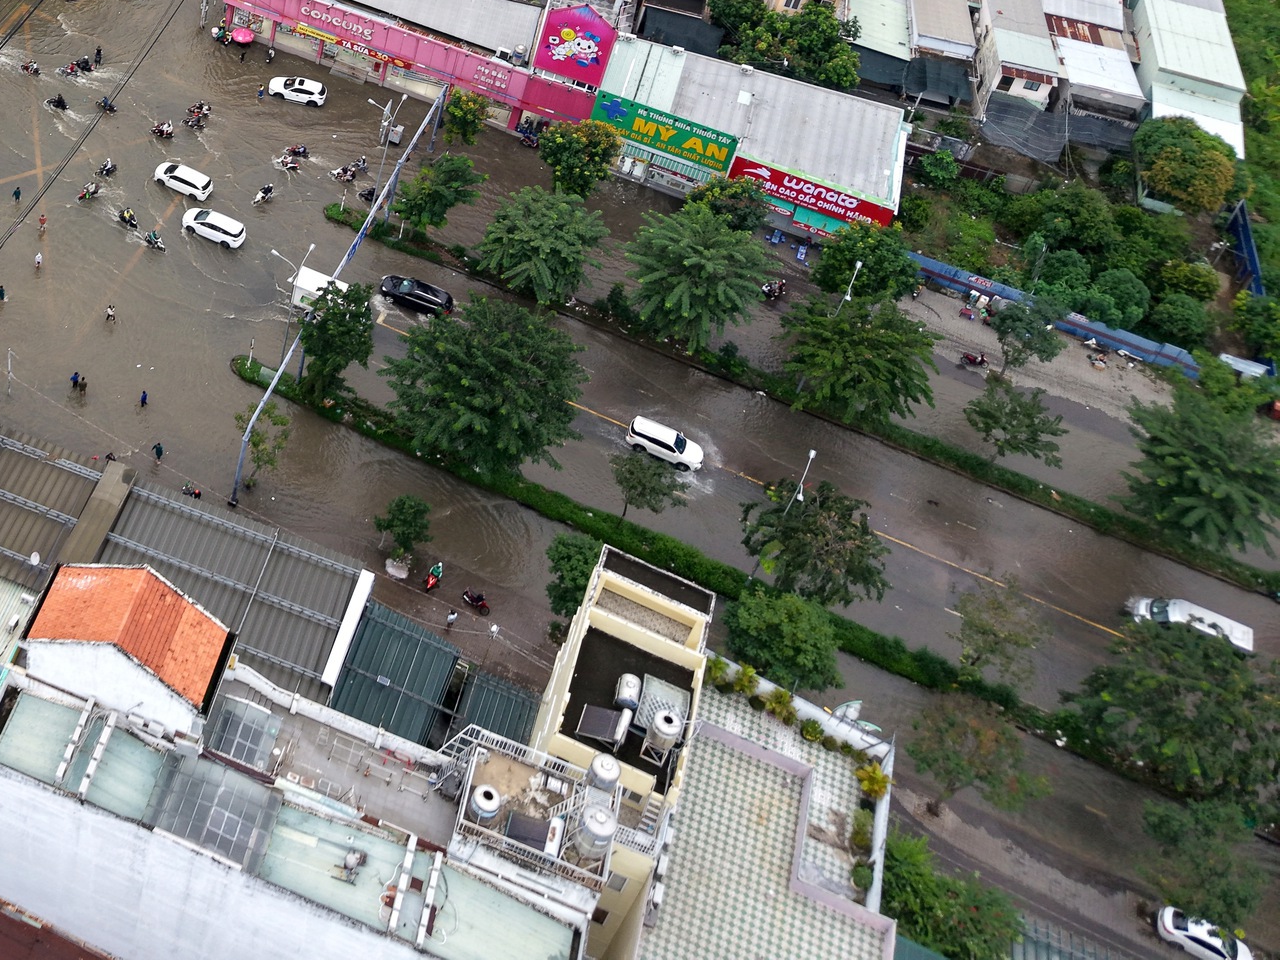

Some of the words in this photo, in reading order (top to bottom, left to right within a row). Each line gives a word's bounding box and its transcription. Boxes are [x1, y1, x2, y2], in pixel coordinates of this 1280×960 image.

[681, 136, 729, 162] AN
[779, 187, 796, 198] CAO
[817, 199, 845, 215] CHÍNH
